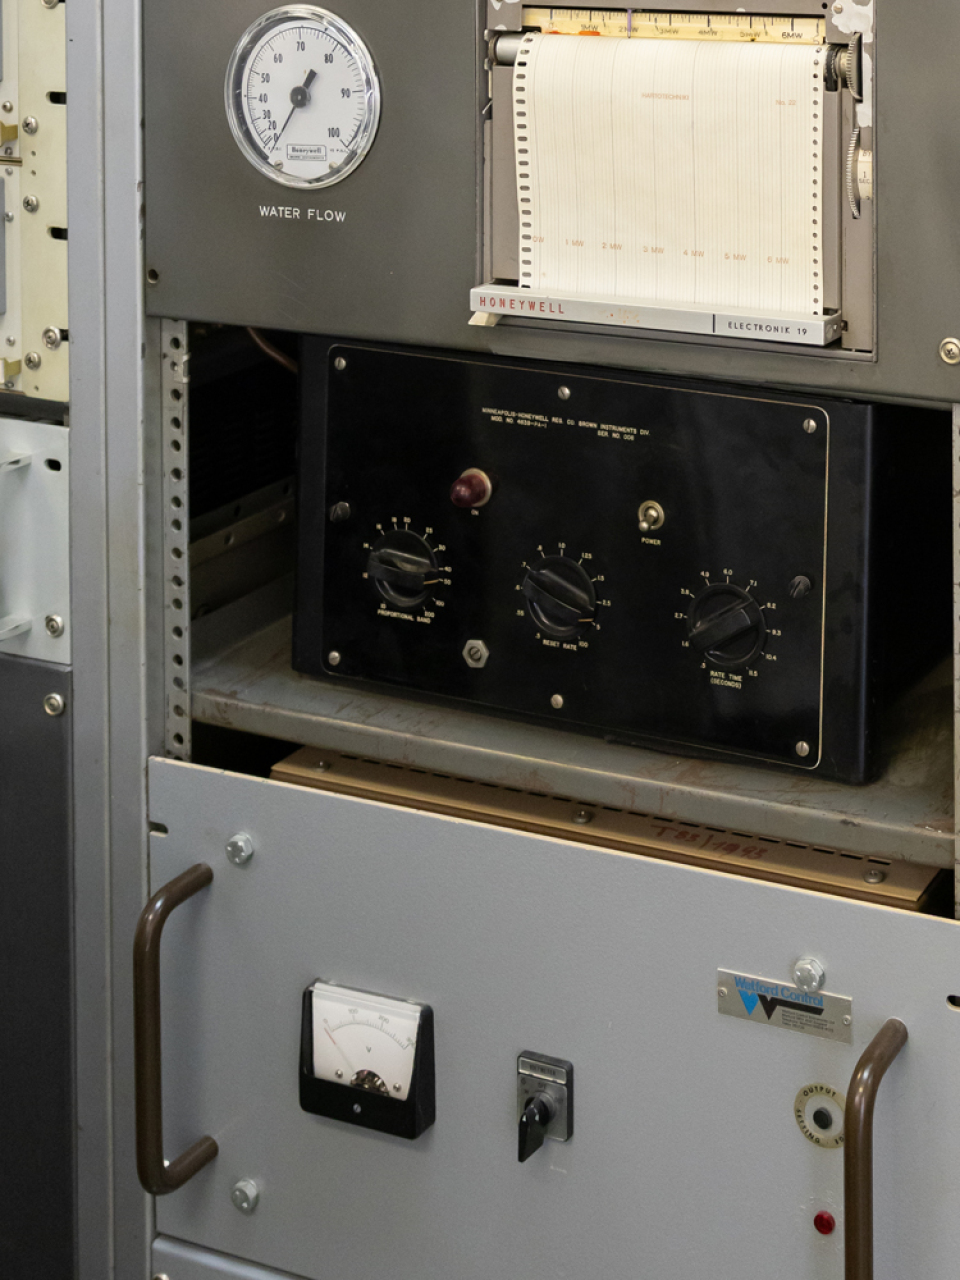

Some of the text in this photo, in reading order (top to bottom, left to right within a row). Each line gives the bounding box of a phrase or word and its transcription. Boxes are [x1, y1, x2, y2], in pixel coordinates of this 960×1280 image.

[781, 31, 803, 39] 6MW
[296, 40, 305, 51] 70
[273, 53, 334, 64] 60 80
[261, 73, 270, 84] 50
[258, 88, 351, 104] 40 90
[262, 110, 271, 120] 30
[268, 120, 340, 138] 20 100
[259, 205, 346, 222] WATER FLOW
[479, 296, 808, 336] HONEYWELL ELECTRONIK 19
[640, 537, 661, 546] POWER
[709, 670, 725, 679] RATE
[803, 1085, 837, 1098] OUTPUT
